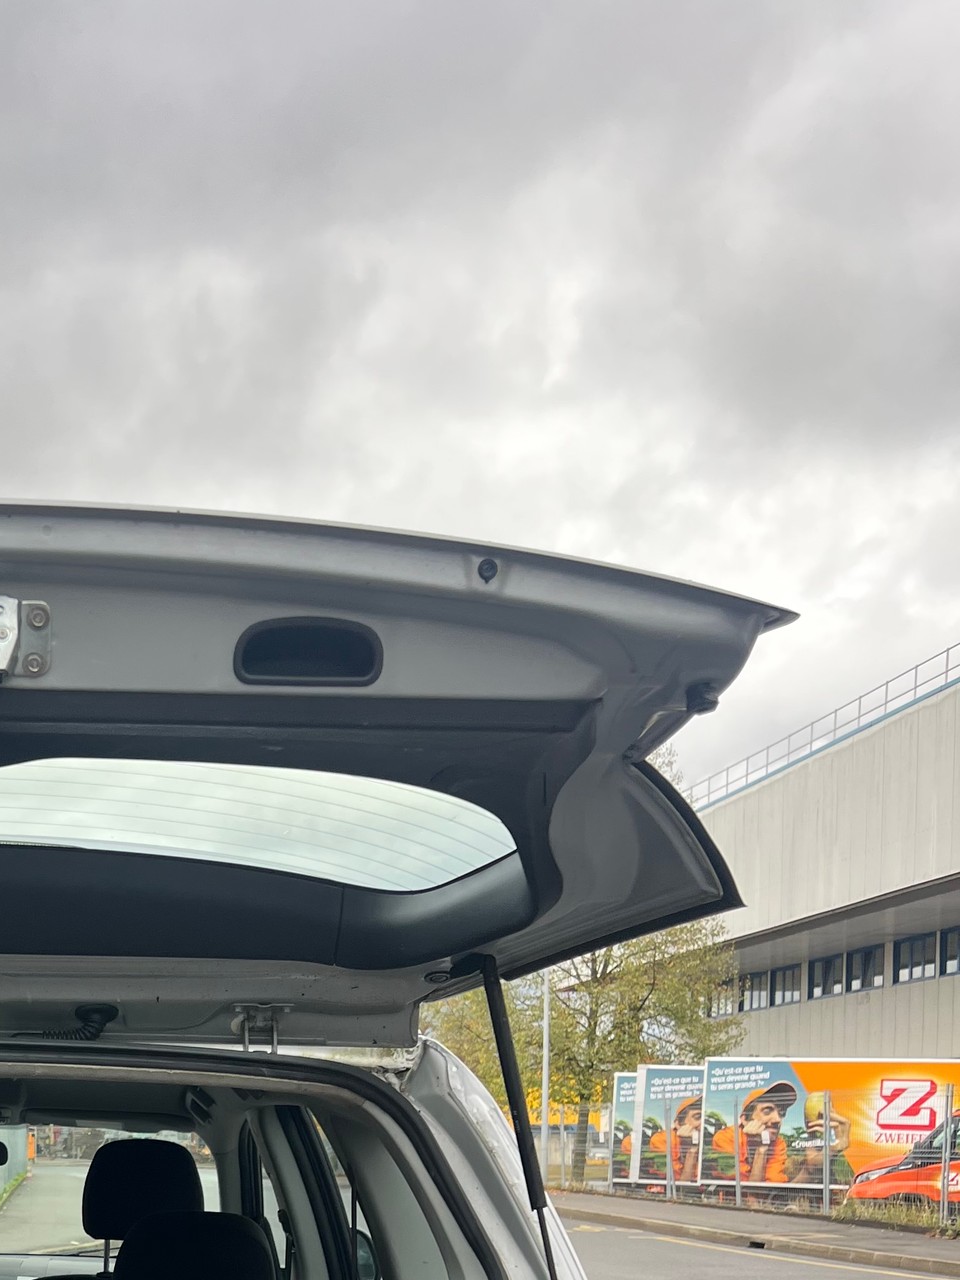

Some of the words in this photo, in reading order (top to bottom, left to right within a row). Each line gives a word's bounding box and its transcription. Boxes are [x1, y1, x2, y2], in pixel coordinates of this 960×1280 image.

[743, 1066, 755, 1074] que
[726, 1074, 749, 1082] devenir
[750, 1072, 770, 1080] quand
[650, 1085, 664, 1093] veux
[665, 1084, 685, 1092] devenir
[735, 1081, 756, 1090] grande
[672, 1091, 692, 1099] grande
[877, 1079, 937, 1131] Z
